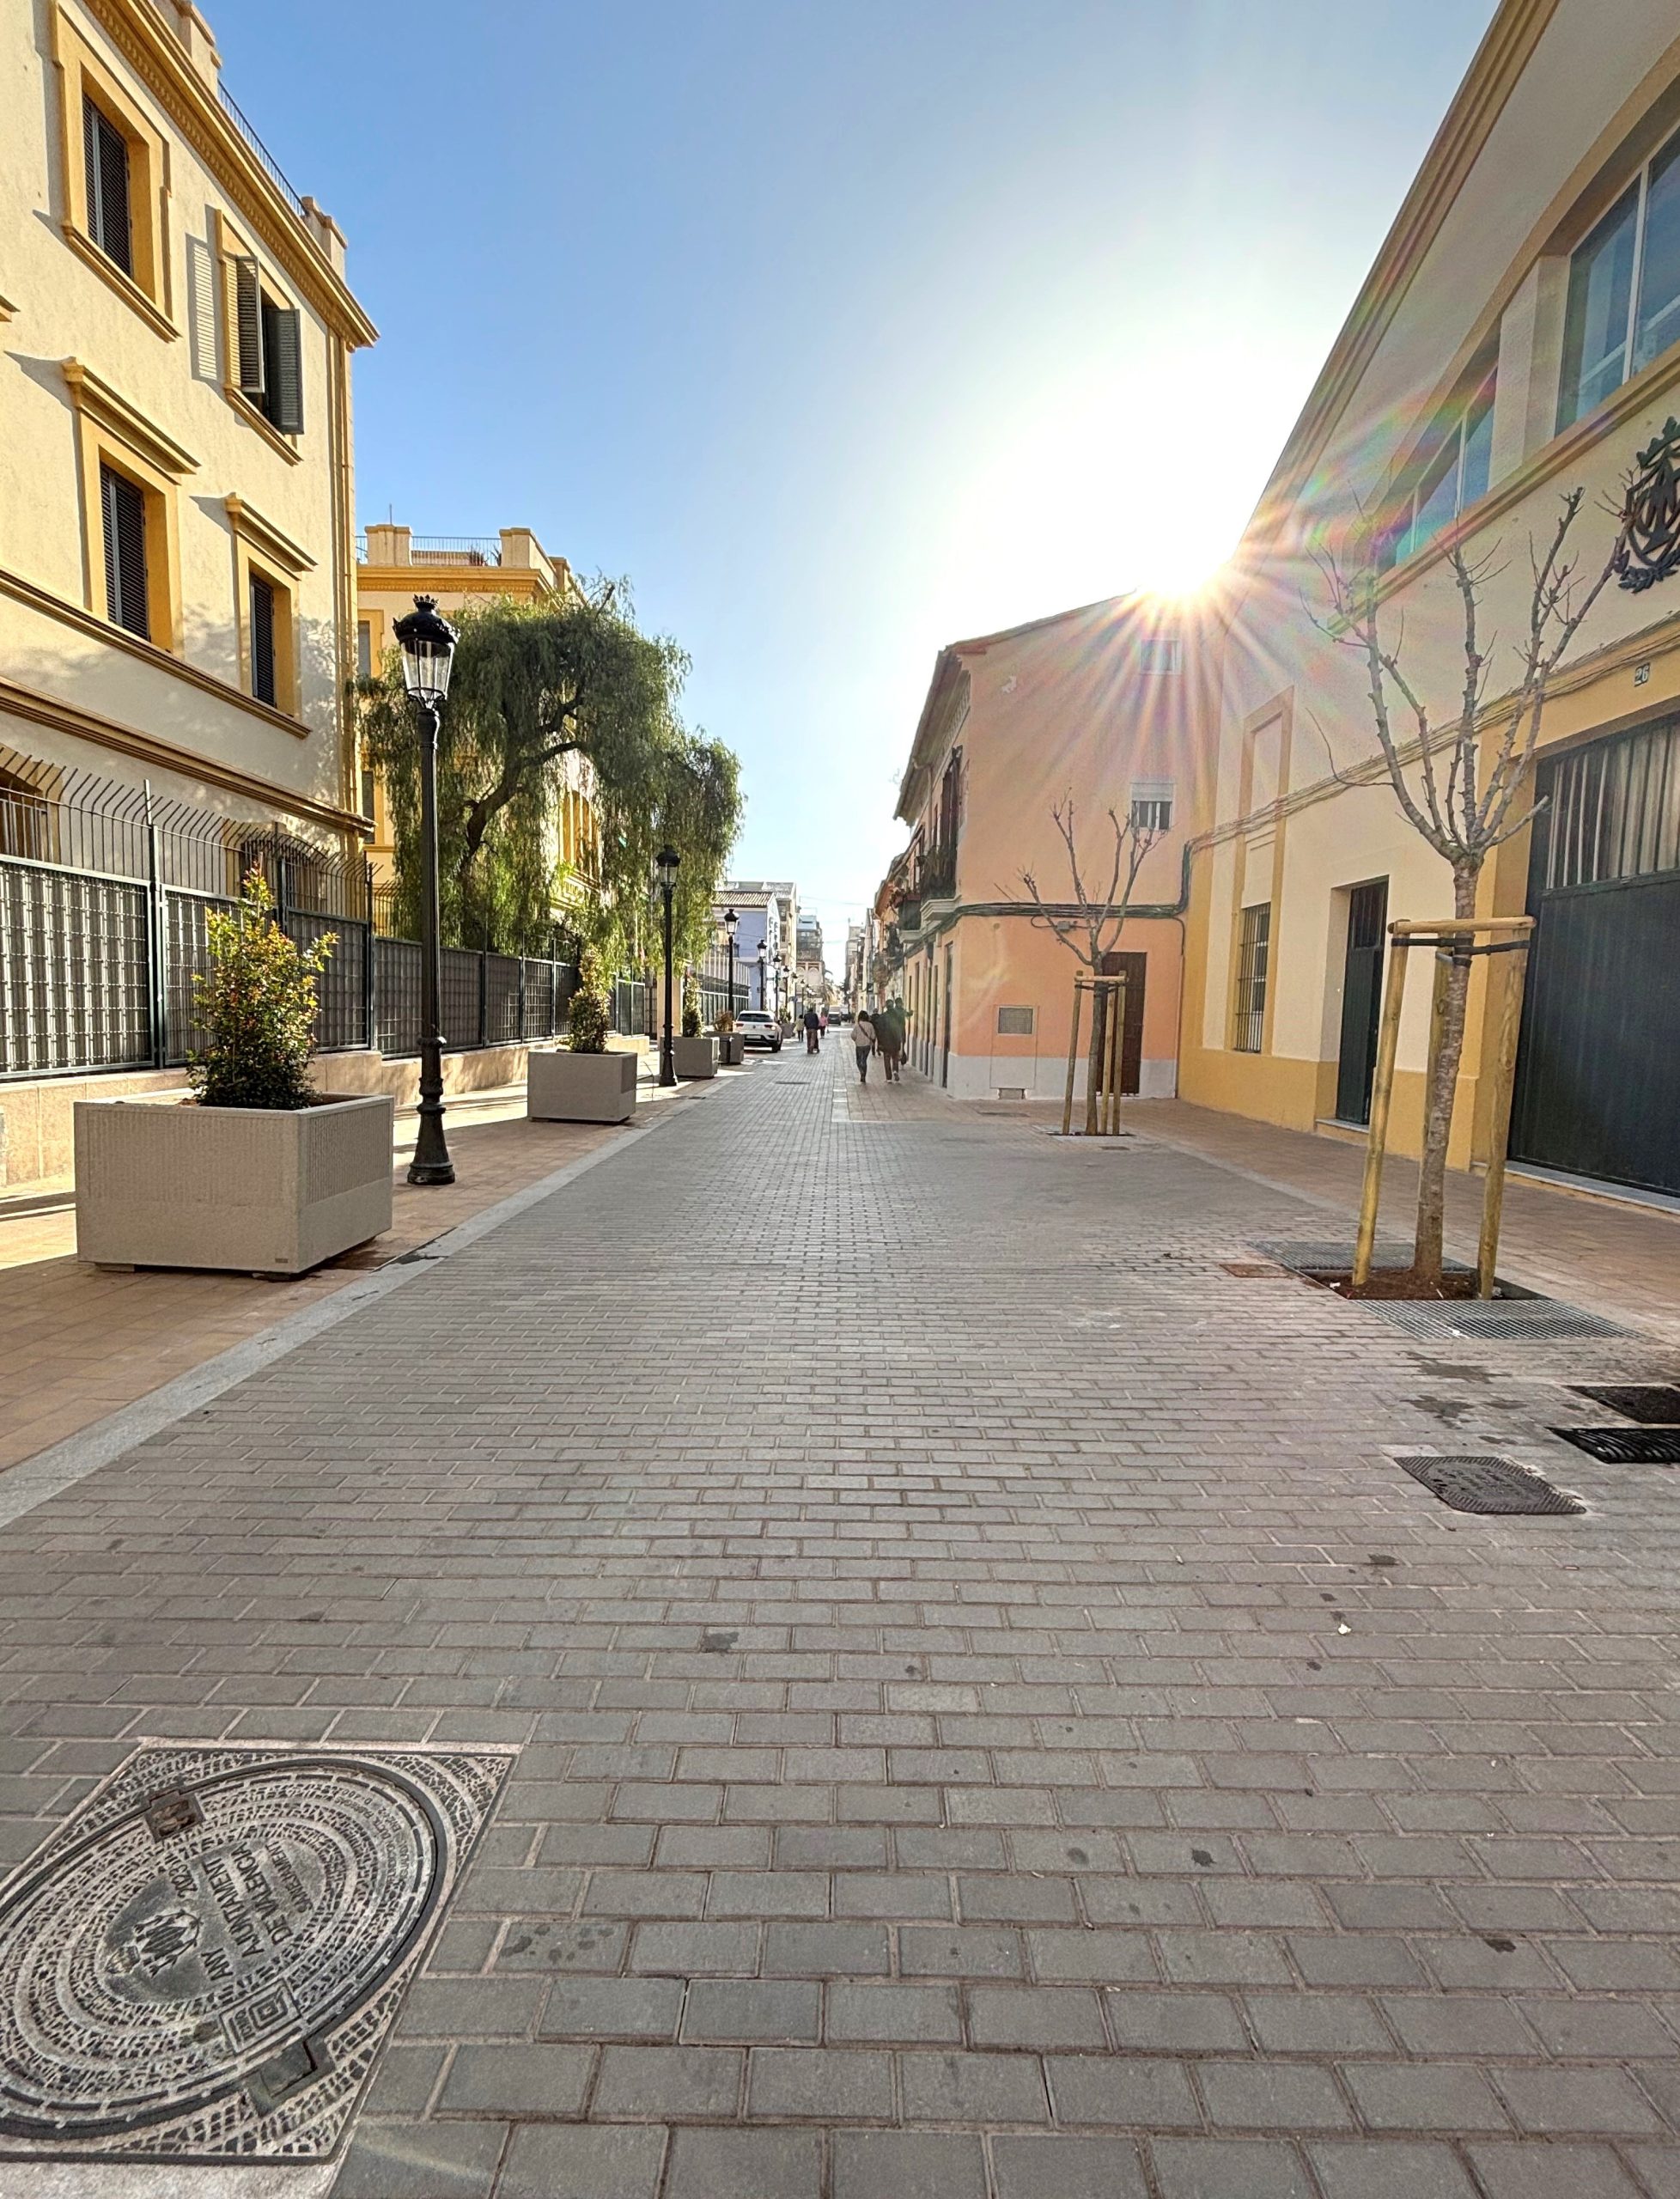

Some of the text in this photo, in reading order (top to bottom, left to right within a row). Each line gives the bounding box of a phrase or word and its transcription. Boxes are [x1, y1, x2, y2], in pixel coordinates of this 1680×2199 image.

[1635, 665, 1649, 685] 26
[202, 1857, 265, 1958] AJUNTAMENT
[265, 1841, 313, 1913] SANEJAMENT
[169, 1863, 233, 1981] ANY 2023
[264, 1914, 293, 1946] DE
